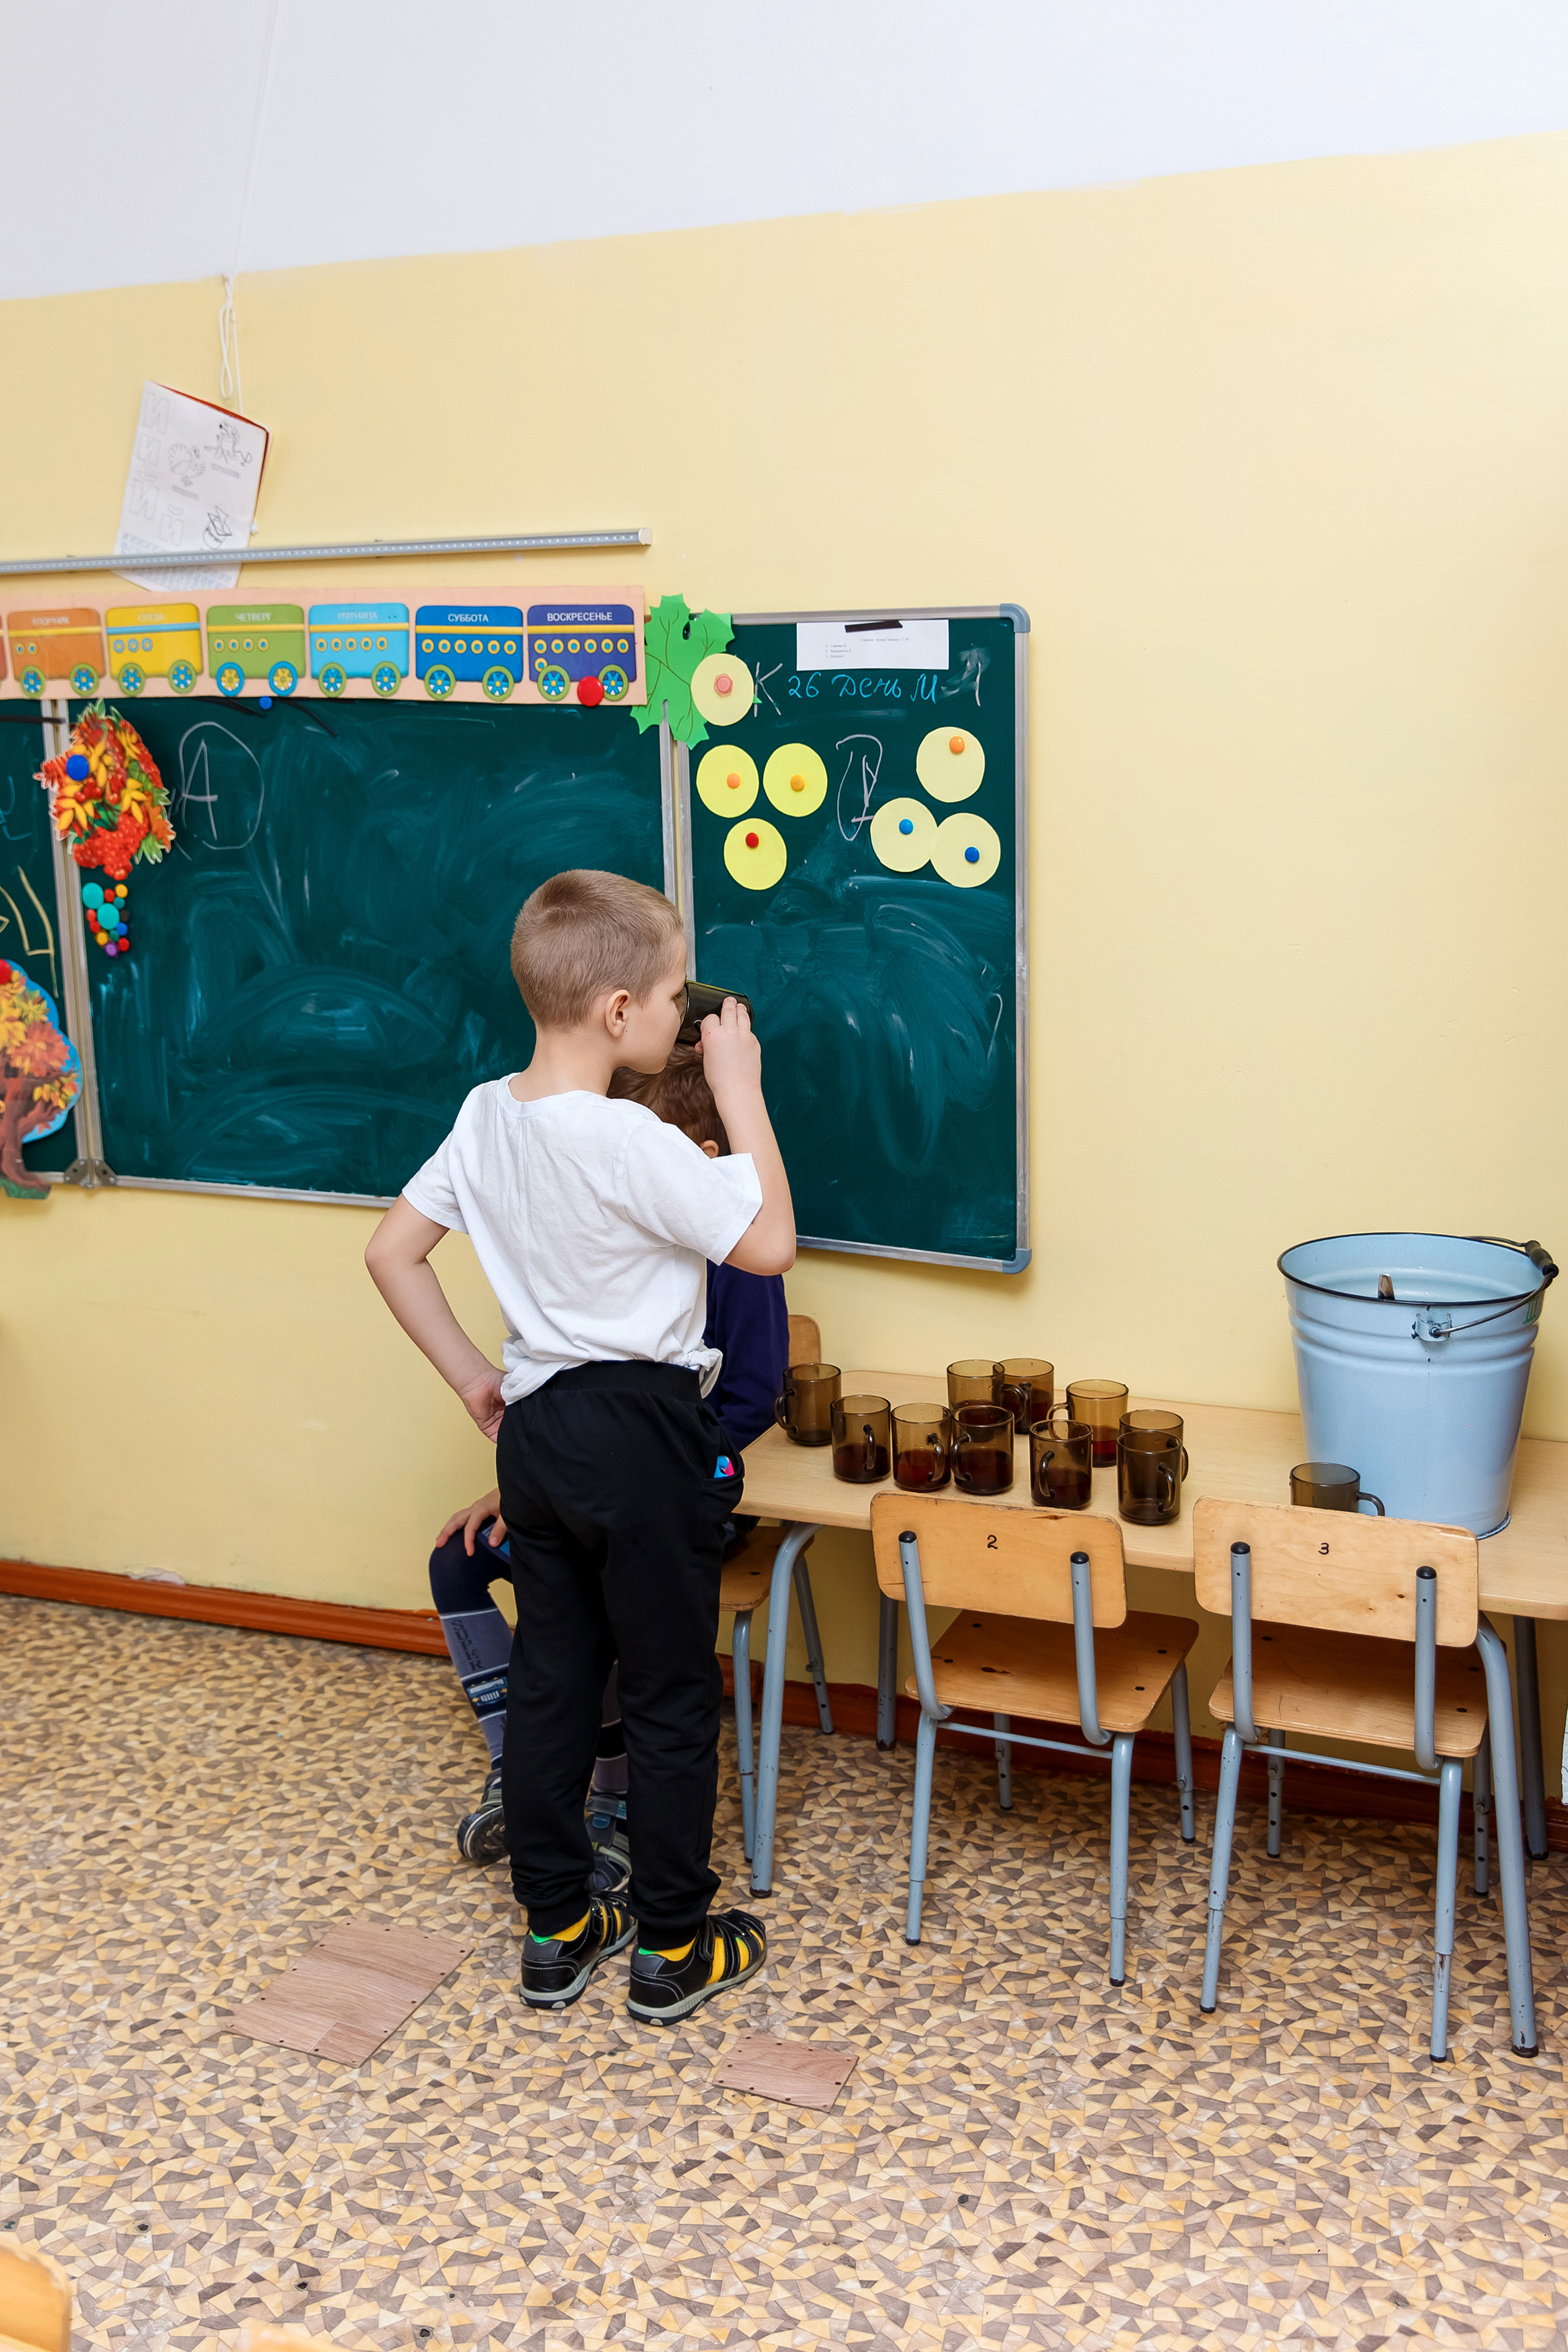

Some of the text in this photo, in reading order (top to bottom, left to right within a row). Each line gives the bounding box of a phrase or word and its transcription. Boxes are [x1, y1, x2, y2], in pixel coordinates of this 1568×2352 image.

[235, 612, 273, 622] ЧЕТВЕРГ
[337, 611, 378, 620] ПЯТНИЦА
[447, 613, 489, 623] СУББОТА
[547, 612, 613, 622] ВОСКРЕСЕНЬЕ
[788, 671, 821, 699] 26
[831, 674, 902, 698] День
[987, 1534, 998, 1550] 2
[1317, 1542, 1329, 1555] 3
[451, 1619, 483, 1672] SUPER
